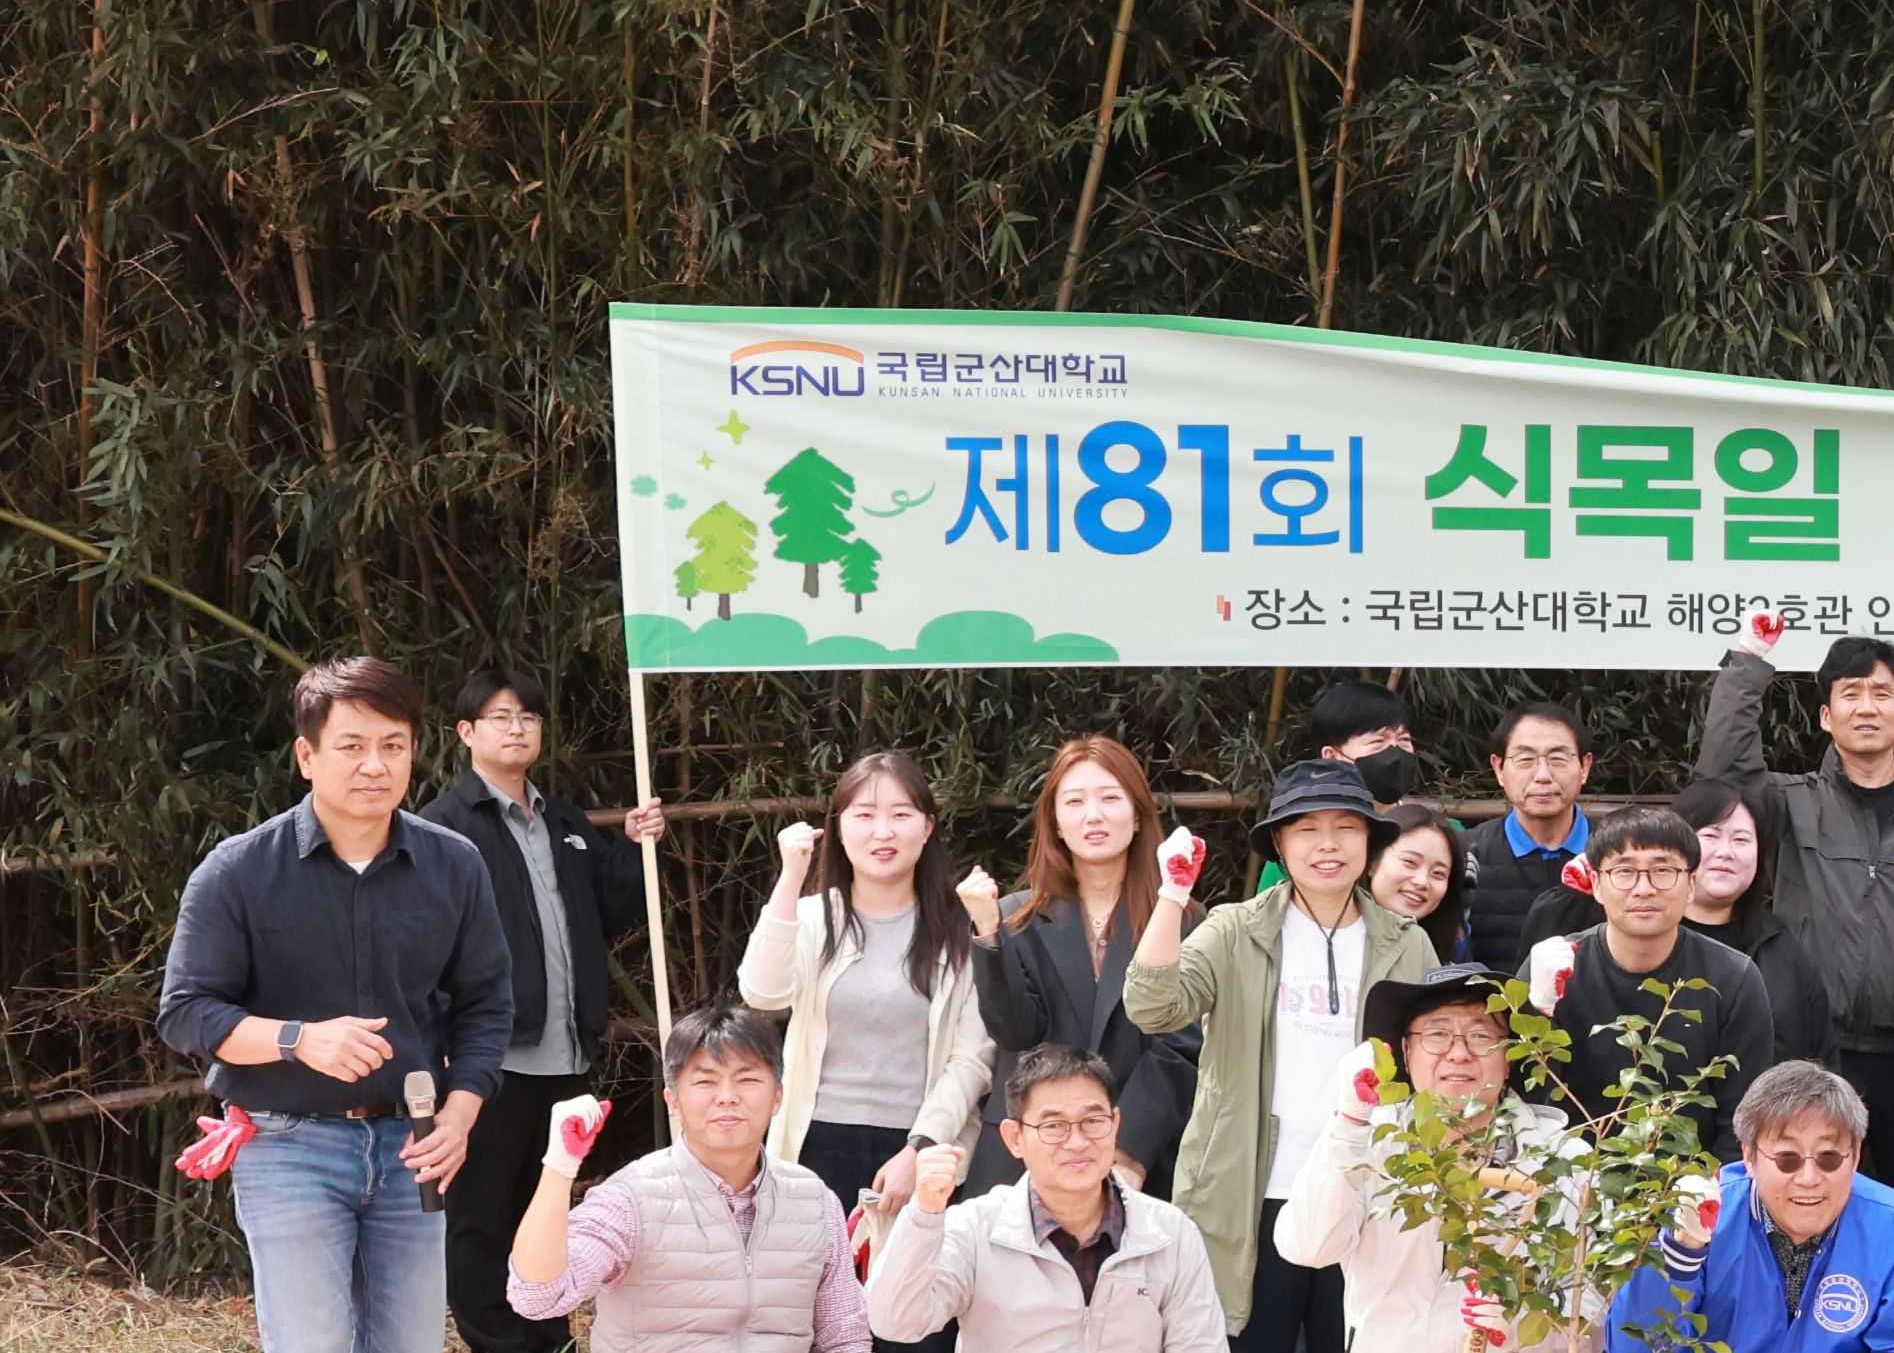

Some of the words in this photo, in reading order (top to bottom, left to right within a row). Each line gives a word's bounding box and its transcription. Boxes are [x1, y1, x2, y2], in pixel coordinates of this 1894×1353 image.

[731, 365, 864, 396] KSNU
[876, 351, 1128, 384] 국립군산대학교
[878, 386, 940, 398] KUNSAN
[953, 387, 1026, 398] NATIONAL
[1038, 388, 1128, 399] UNIVERSITY
[944, 419, 1365, 556] 제81회
[1425, 423, 1842, 562] 식목일
[1245, 588, 1327, 630] 장소
[1365, 589, 1652, 633] 국립군산대학교
